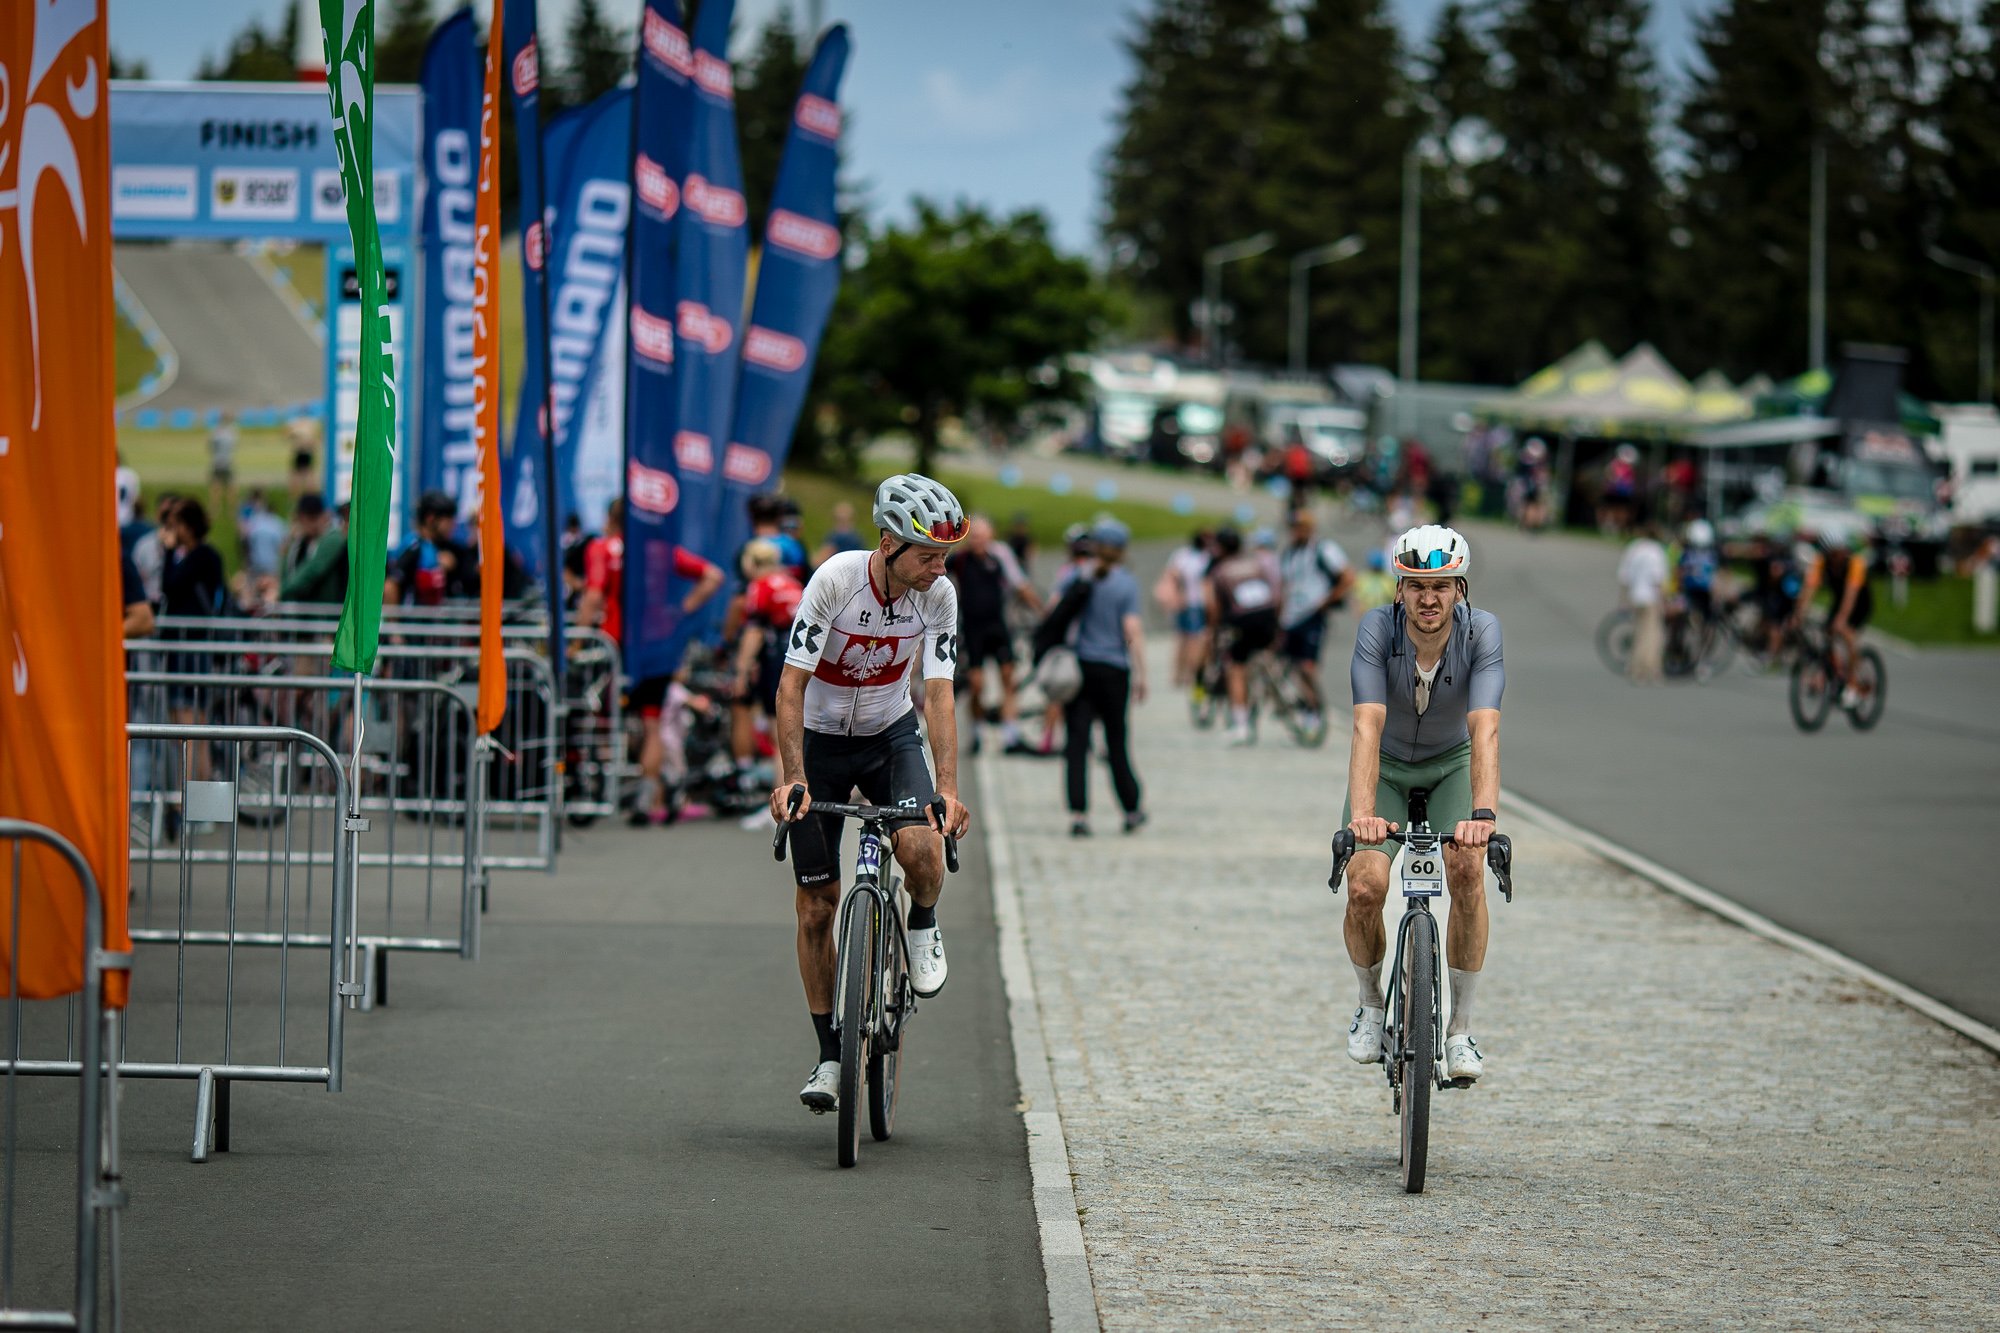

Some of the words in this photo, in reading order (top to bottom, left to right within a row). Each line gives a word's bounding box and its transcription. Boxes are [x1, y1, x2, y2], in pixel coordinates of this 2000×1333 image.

[202, 118, 318, 147] FINISH
[1411, 860, 1434, 875] 60
[808, 873, 830, 882] KOLOS
